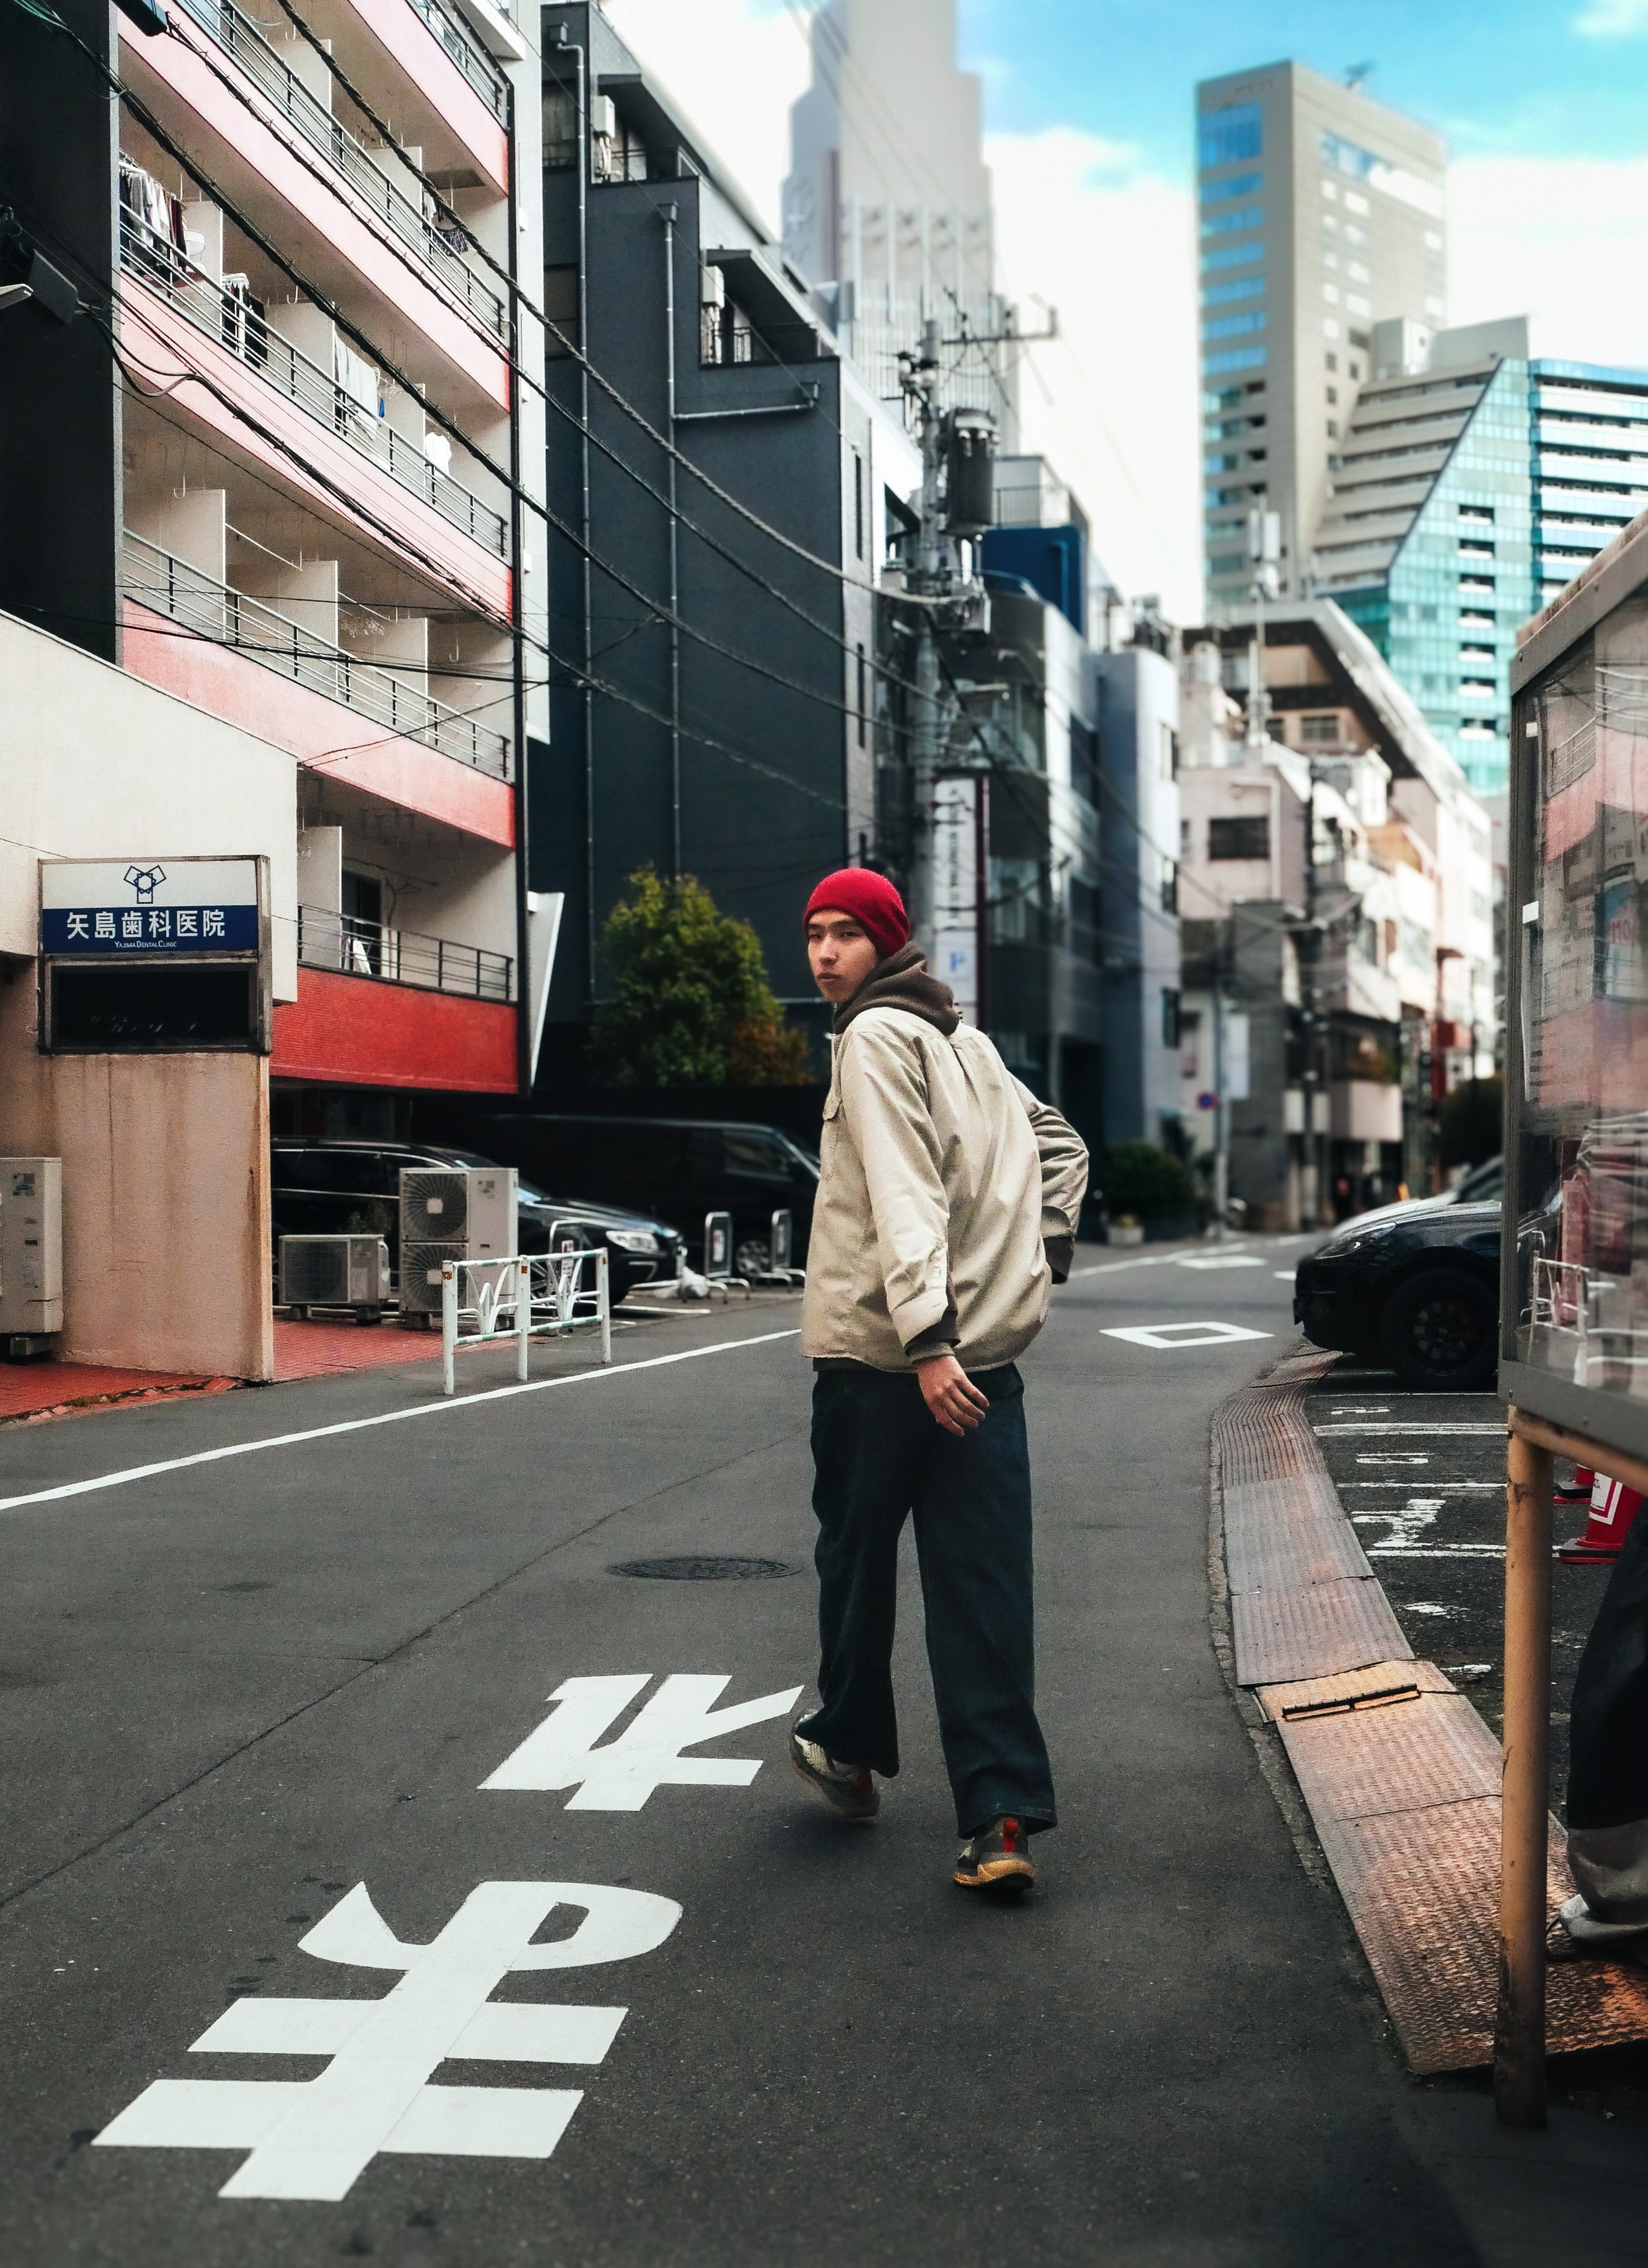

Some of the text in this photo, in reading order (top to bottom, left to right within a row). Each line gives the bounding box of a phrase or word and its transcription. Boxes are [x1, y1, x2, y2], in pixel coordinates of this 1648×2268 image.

[66, 909, 225, 939] 矢島歯科医院
